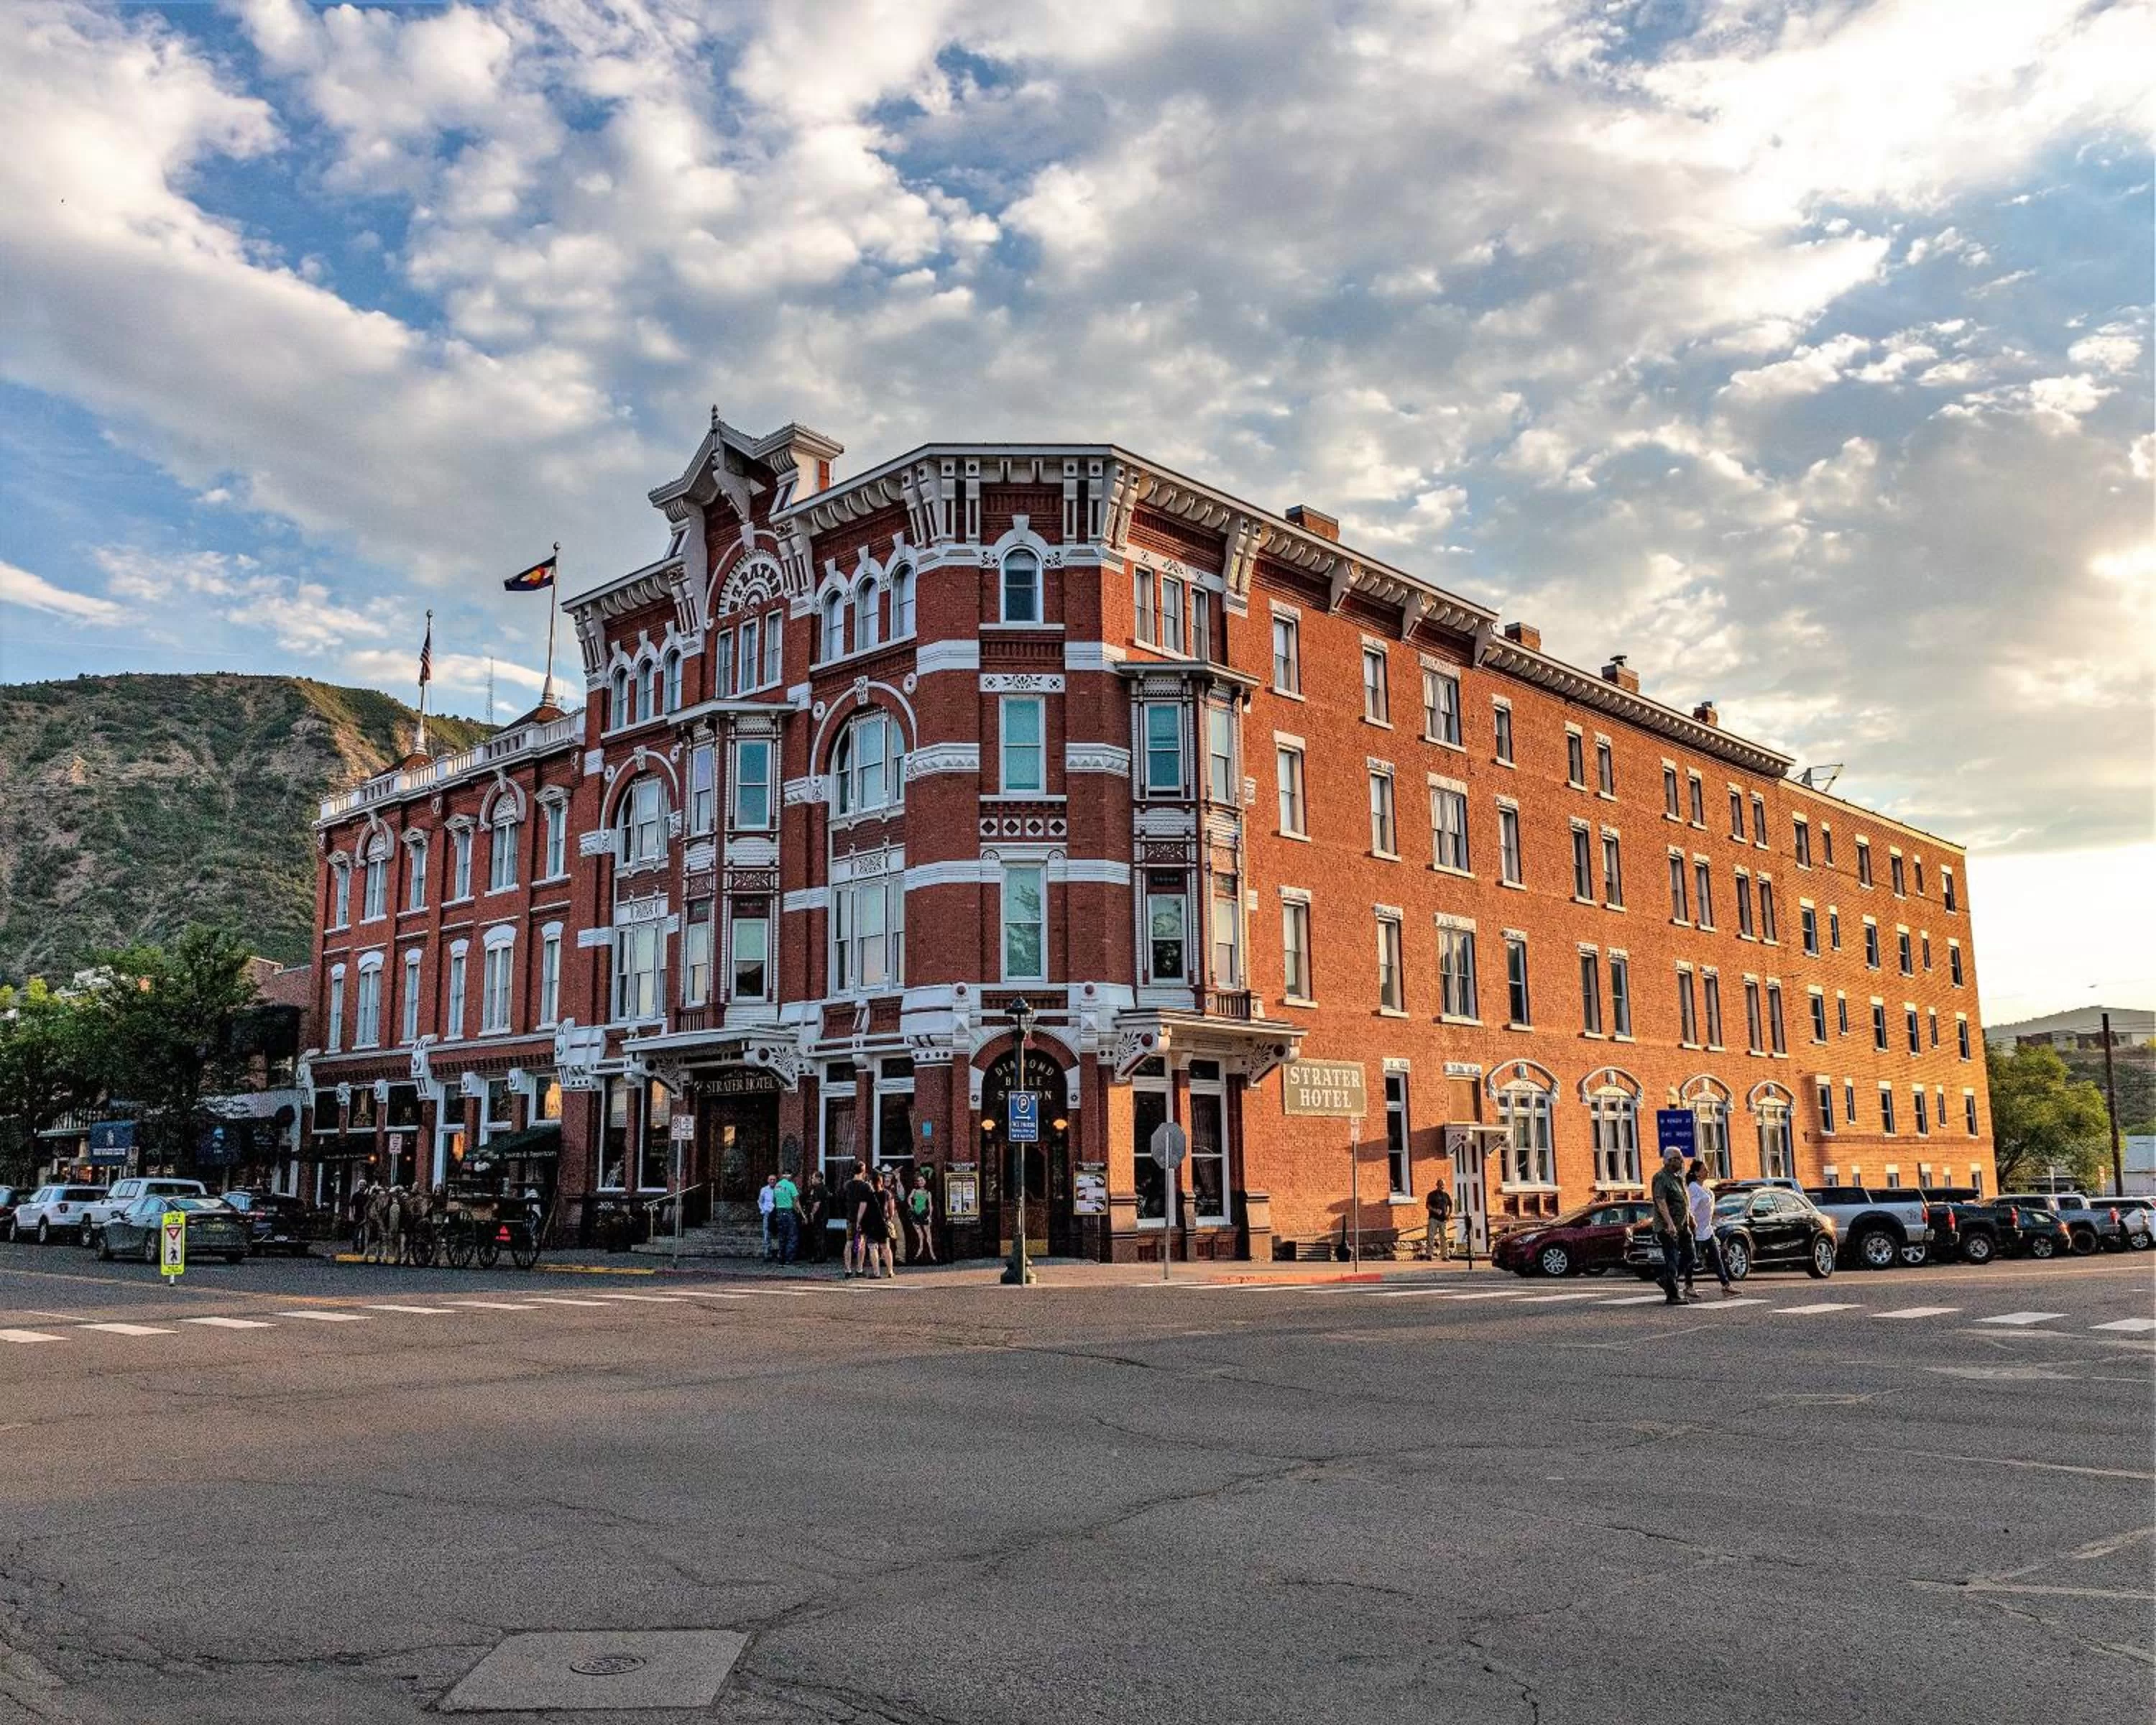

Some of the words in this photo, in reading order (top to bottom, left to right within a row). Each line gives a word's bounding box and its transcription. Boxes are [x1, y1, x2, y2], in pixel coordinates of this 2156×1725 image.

[729, 562, 781, 612] STRATER
[995, 1059, 1054, 1076] DIAOND
[706, 1080, 744, 1093] STRATER
[745, 1076, 776, 1091] HOTEL
[1005, 1076, 1043, 1086] BLE
[1290, 1066, 1361, 1087] STRATER
[997, 1090, 1053, 1100] SON
[1299, 1087, 1352, 1108] HOTEL
